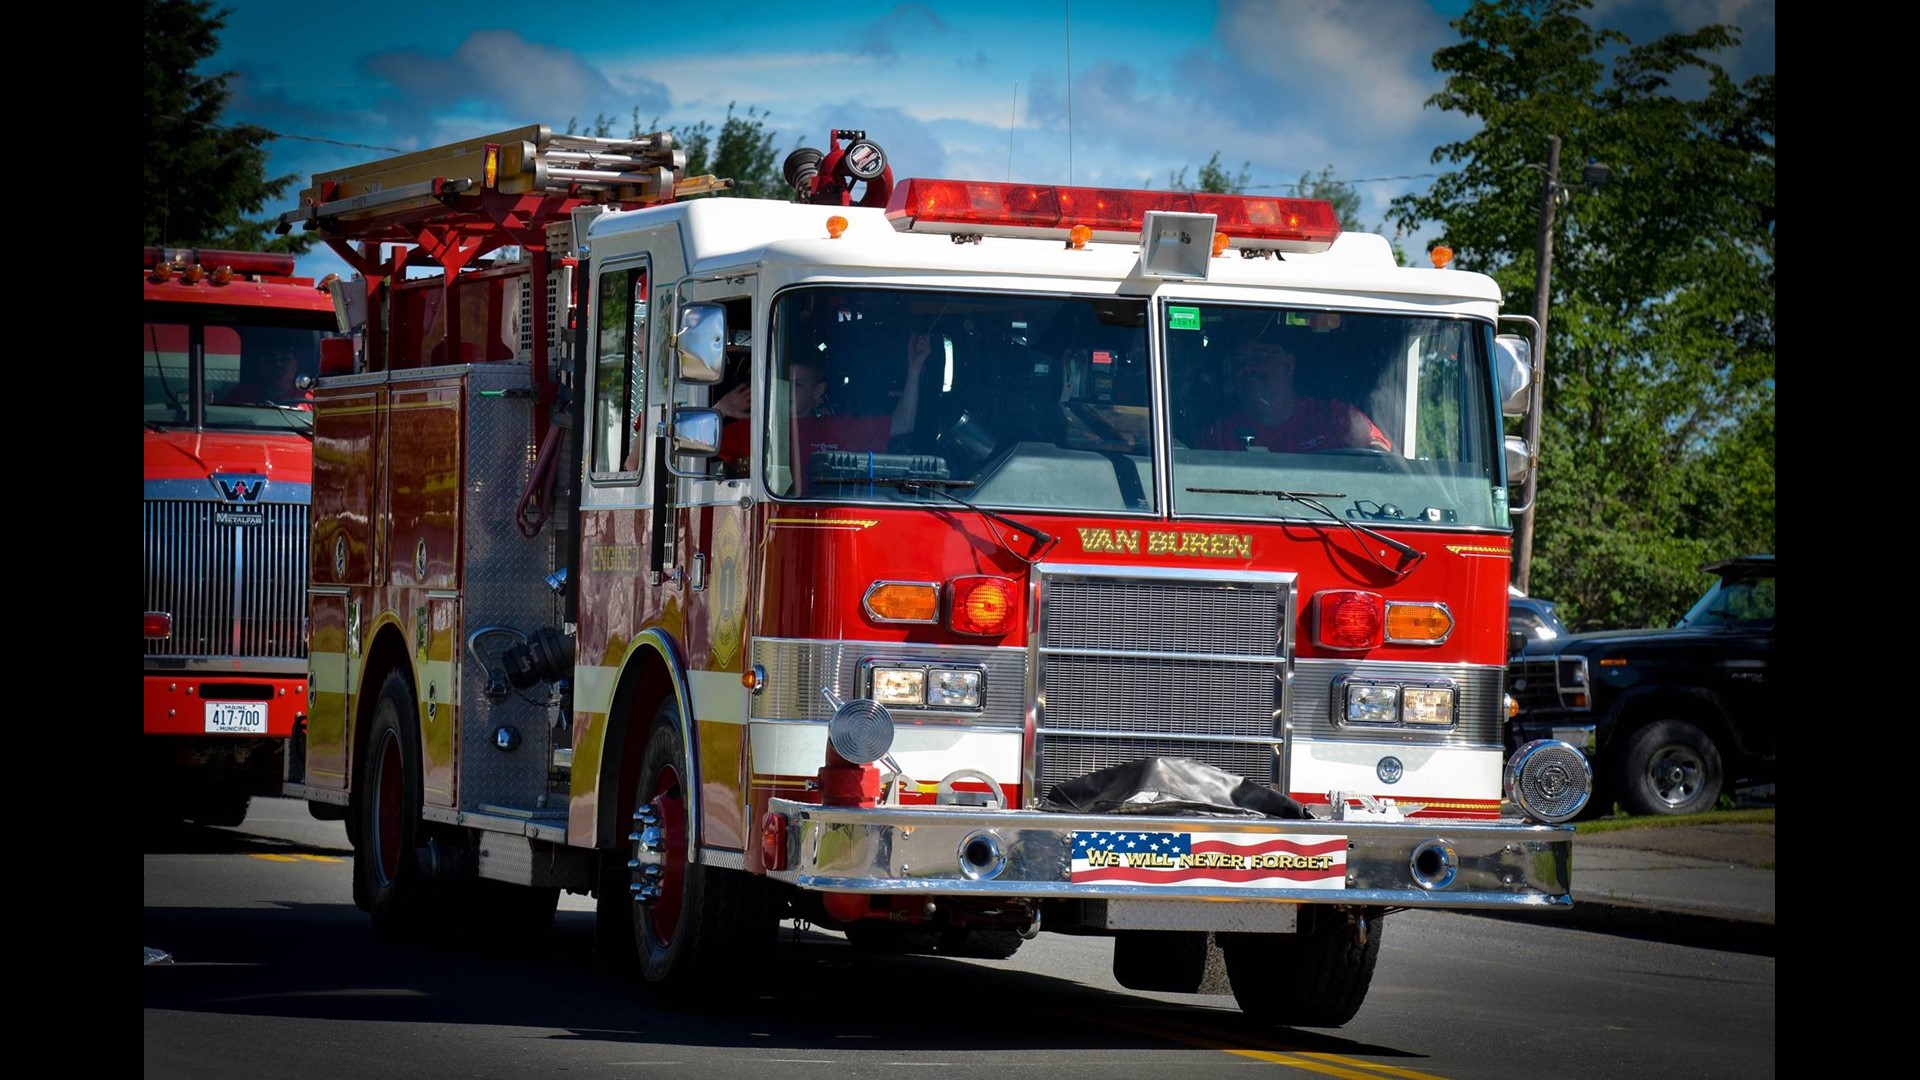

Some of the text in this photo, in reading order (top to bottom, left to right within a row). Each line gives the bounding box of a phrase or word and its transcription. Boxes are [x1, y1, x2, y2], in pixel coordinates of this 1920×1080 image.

[216, 513, 262, 524] METALFAB
[1077, 527, 1253, 559] VAN BUREN
[592, 545, 633, 571] ENGINE
[212, 710, 260, 726] 417-700
[1086, 849, 1333, 871] WE WILL NEVER FORGET
